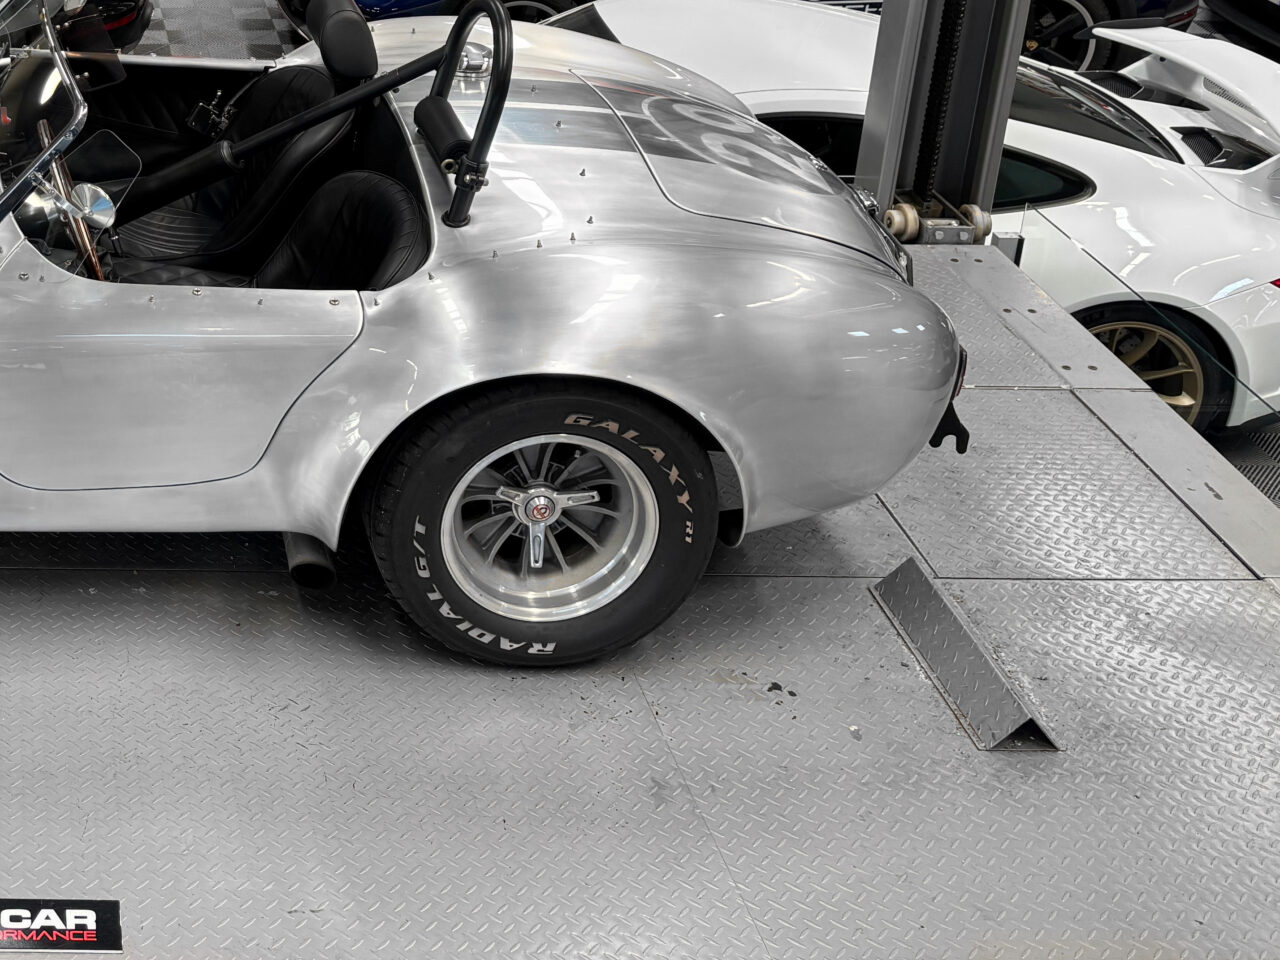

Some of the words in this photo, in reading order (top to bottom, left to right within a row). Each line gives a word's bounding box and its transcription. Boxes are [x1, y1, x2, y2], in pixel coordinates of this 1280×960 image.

[564, 413, 694, 514] GALAXY
[426, 582, 558, 655] RADIAL
[0, 908, 97, 930] CAR
